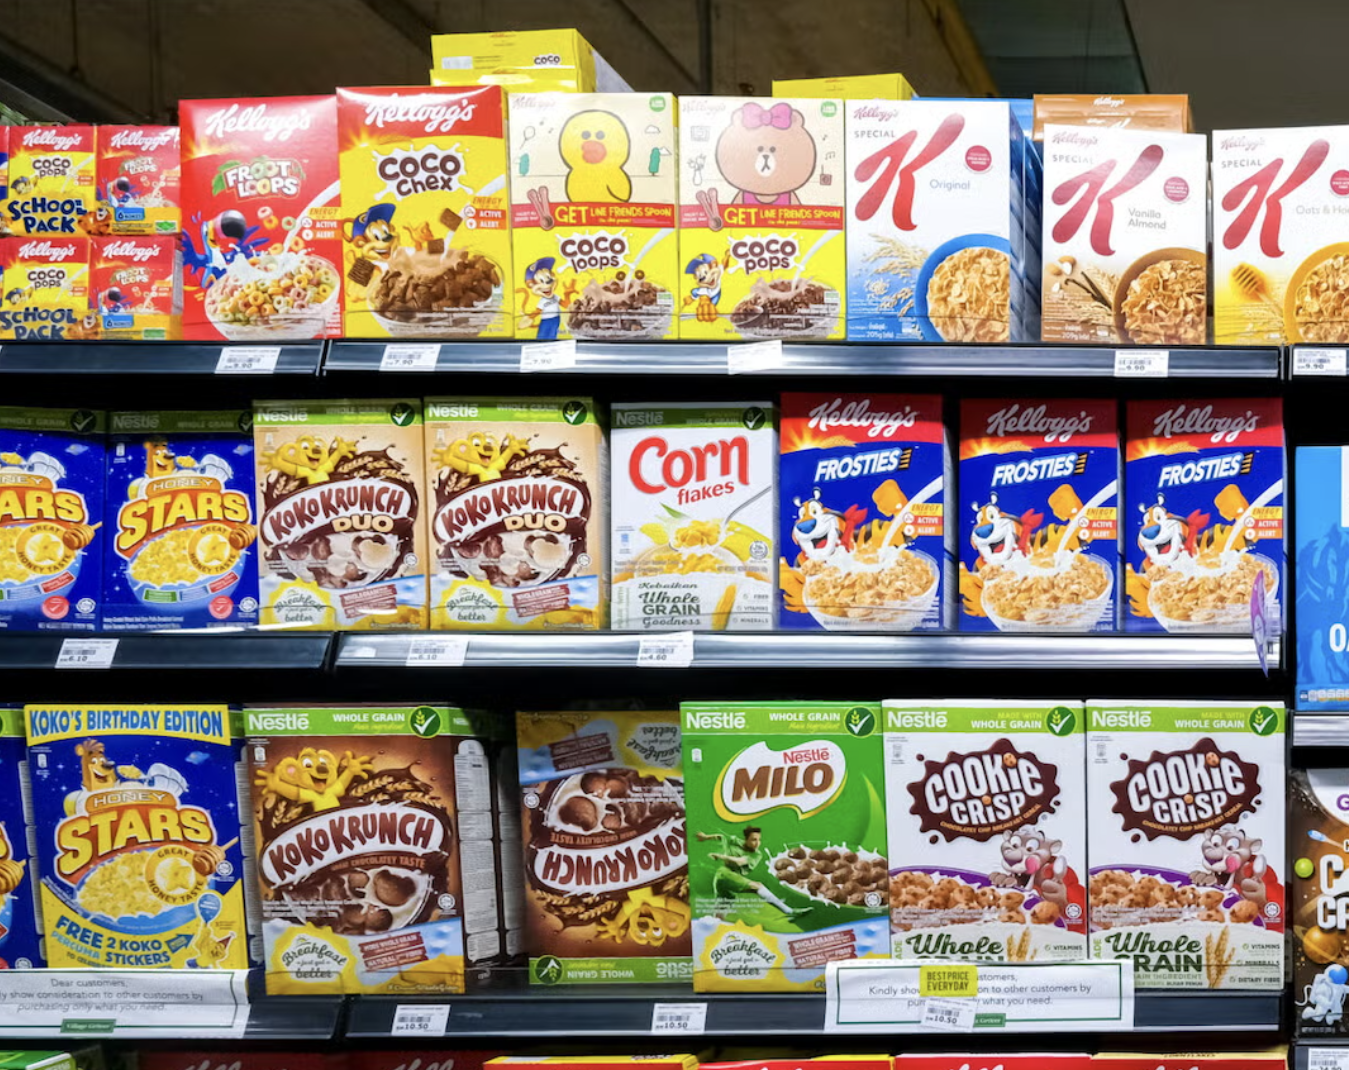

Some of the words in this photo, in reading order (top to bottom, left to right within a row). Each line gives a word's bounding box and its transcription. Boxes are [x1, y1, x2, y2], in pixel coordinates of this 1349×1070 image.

[206, 104, 311, 141] Kellogg's
[23, 130, 82, 150] Kellogg's
[854, 130, 895, 139] SPECIAL
[378, 154, 461, 179] COCO
[854, 113, 965, 231] K
[930, 179, 970, 191] Original
[8, 198, 87, 220] SCHOOL
[1127, 208, 1161, 219] Vanilla
[1296, 205, 1319, 215] Oats
[1323, 205, 1330, 215] &
[24, 217, 76, 233] PACK
[1127, 218, 1166, 230] Almond
[808, 400, 917, 437] Kellogg's
[628, 436, 750, 494] Corn
[814, 448, 899, 484] FROSTIES
[153, 477, 212, 490] HONEY
[677, 482, 734, 506] flakes
[118, 493, 251, 548] STARS
[333, 514, 394, 532] DUO
[639, 591, 699, 604] Whole
[643, 603, 700, 616] GRAIN
[31, 712, 82, 738] KOKO'S
[87, 711, 159, 734] BIRTHDAY
[165, 711, 222, 736] EDITION
[332, 714, 365, 723] WHOLE
[369, 713, 405, 722] GRAIN
[971, 719, 1003, 729] WHOLE
[1006, 719, 1042, 729] GRAIN
[732, 765, 834, 802] MILO
[57, 809, 211, 872] STARS
[55, 916, 102, 949] FREE
[107, 937, 116, 949] 2
[120, 938, 162, 953] KOKO
[906, 933, 1003, 955] Whole
[104, 951, 170, 965] STICKERS
[868, 986, 897, 997] Kindly
[927, 981, 969, 991] EVERYDAY
[982, 997, 1004, 1006] what
[1007, 999, 1024, 1008] you
[1026, 996, 1053, 1005] need.
[404, 1023, 428, 1031] 10.50
[934, 1015, 957, 1024] 10.50
